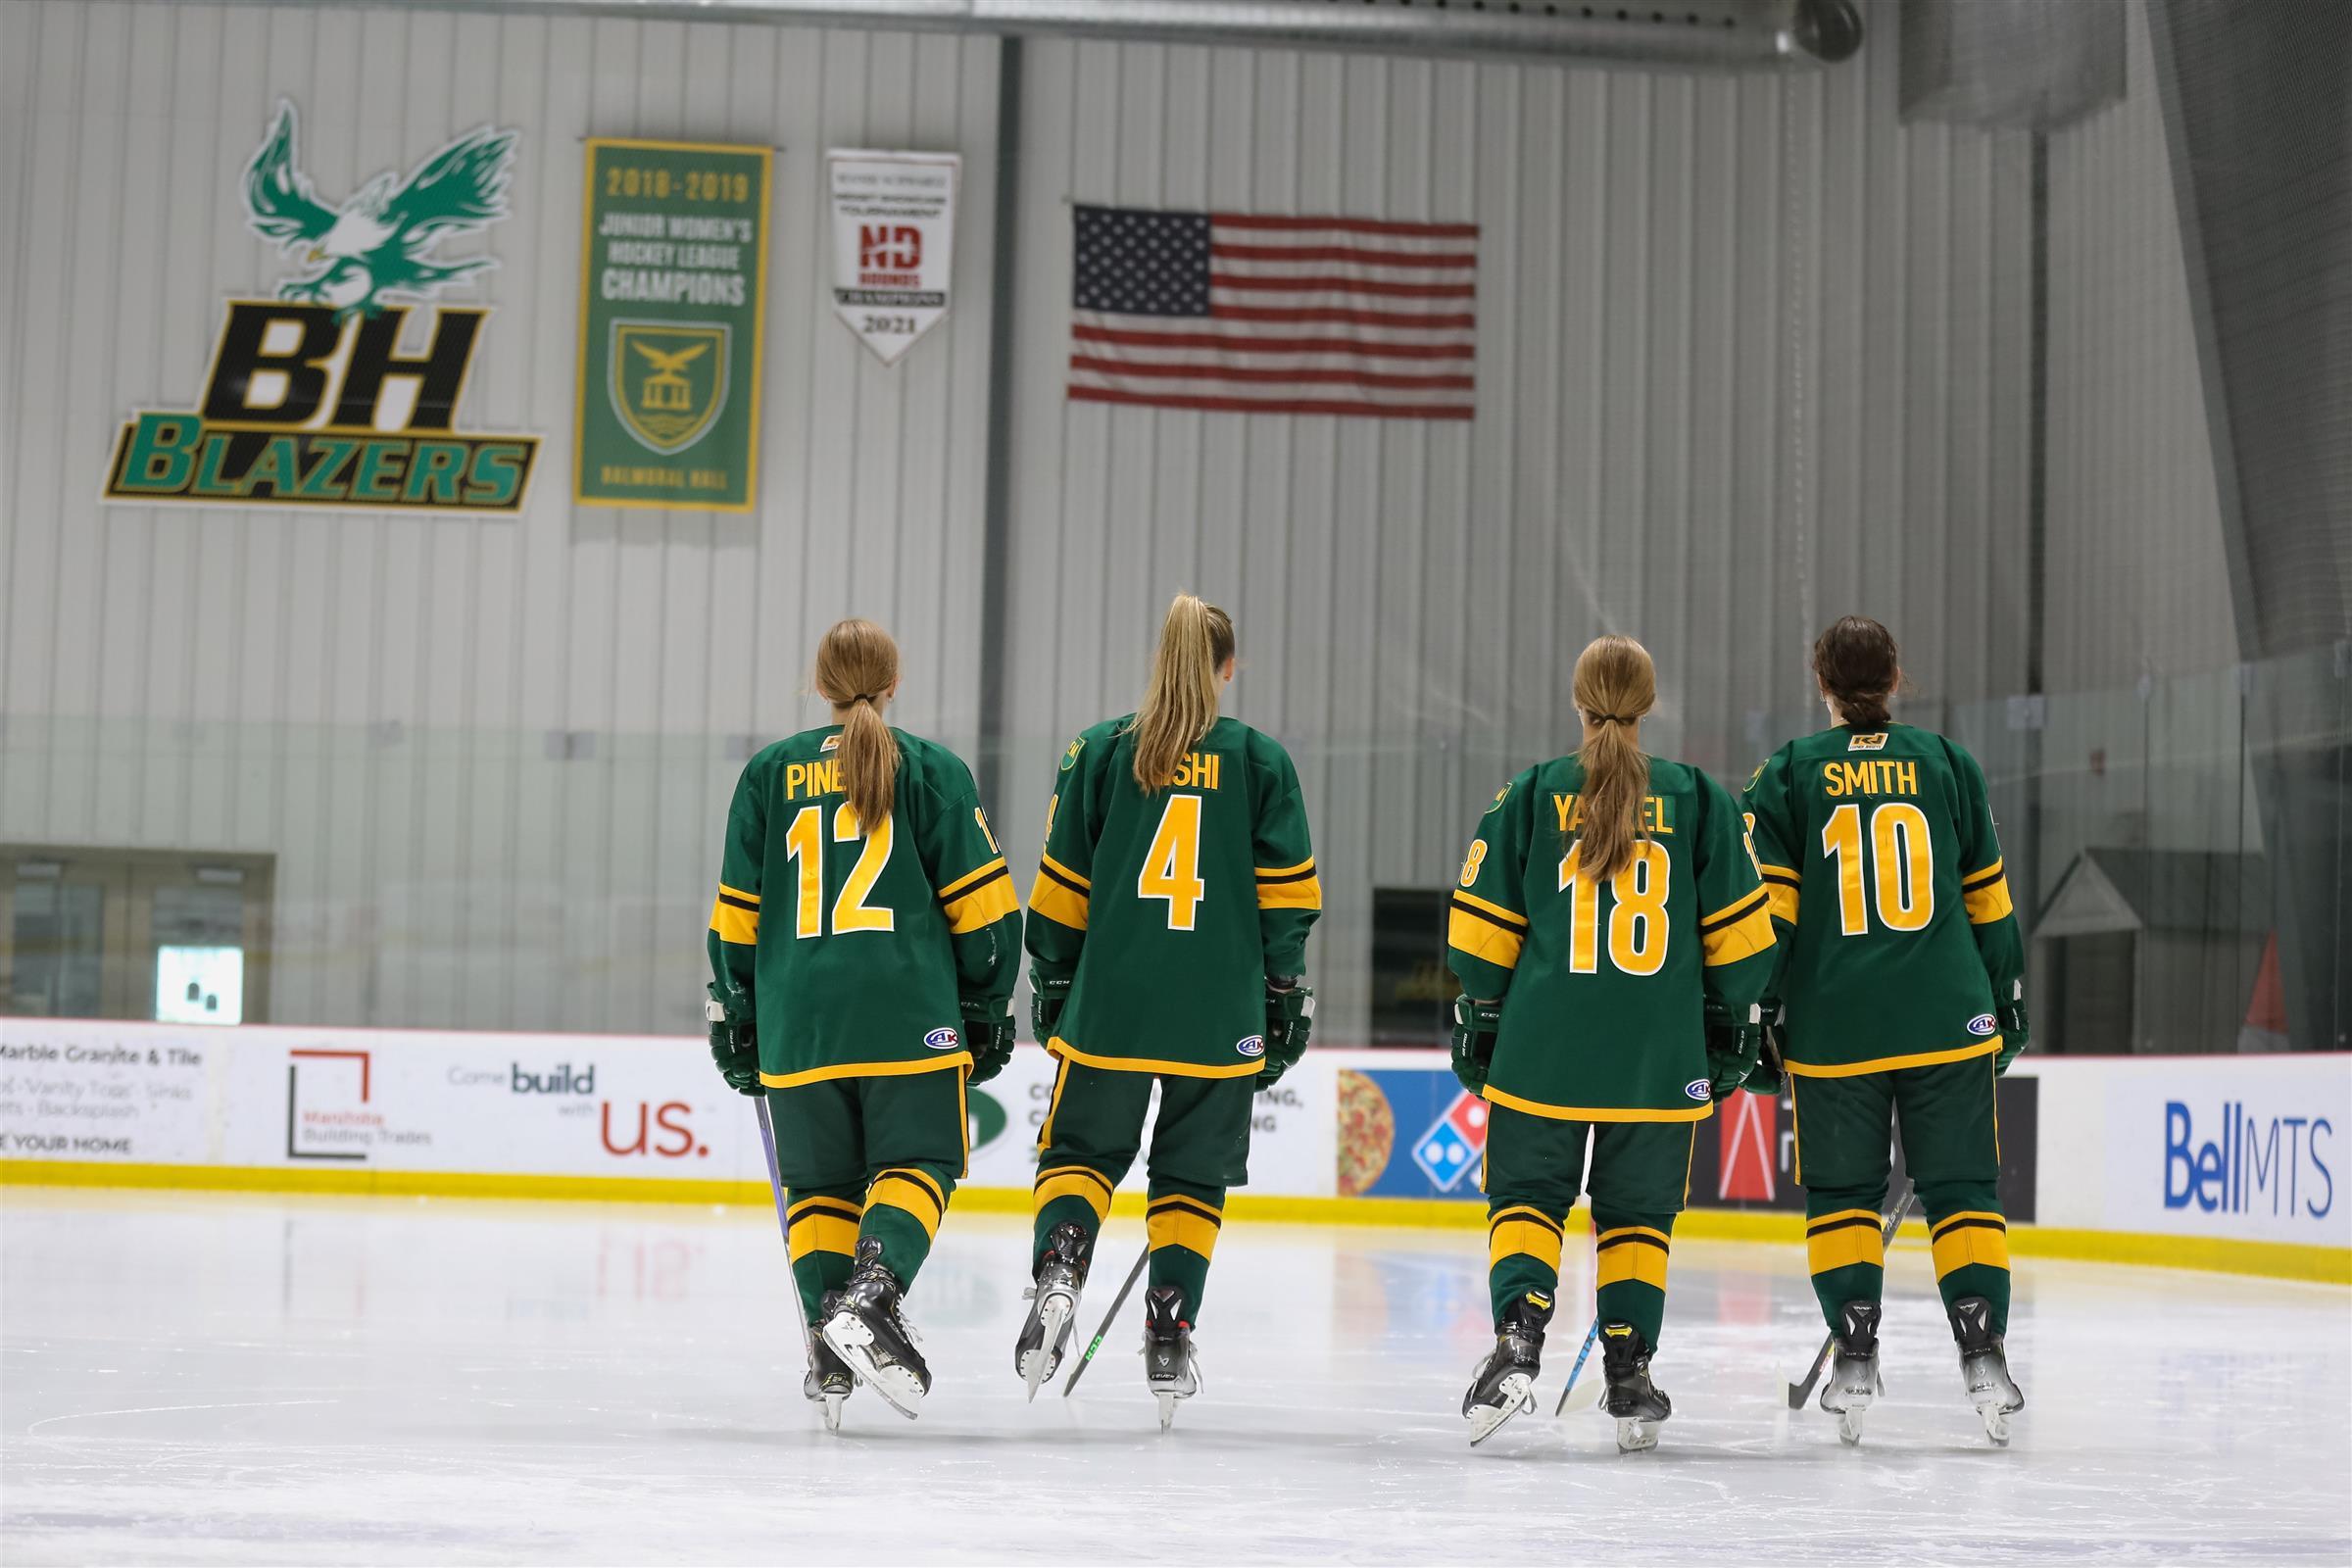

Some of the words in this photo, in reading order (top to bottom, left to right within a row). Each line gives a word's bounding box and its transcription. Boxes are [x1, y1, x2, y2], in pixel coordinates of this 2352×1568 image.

[607, 168, 749, 203] 2018-2019
[599, 213, 665, 237] JUNIOR
[668, 216, 752, 243] WOMEN'S
[859, 225, 922, 270] ND
[608, 240, 675, 266] HOCKEY
[676, 245, 740, 270] LEAGUE
[602, 267, 746, 307] CHAMPIONS
[864, 315, 916, 334] 2021
[201, 299, 490, 431] BH
[117, 412, 525, 505] BLAZERS
[787, 760, 848, 801] PINE
[1171, 752, 1220, 791] SHI
[1824, 760, 1918, 797] SMITH
[1553, 794, 1674, 834] YAEL
[786, 801, 894, 940] 12
[1138, 794, 1205, 931] 4
[1460, 839, 1488, 887] 8
[1821, 802, 1935, 936] 10
[1558, 838, 1671, 976] 18
[64, 1044, 141, 1064] Granite
[148, 1048, 160, 1066] &
[168, 1048, 203, 1066] Tile
[447, 1065, 506, 1086] Come
[511, 1061, 596, 1095] build
[14, 1134, 70, 1152] YOUR
[74, 1137, 132, 1154] HOME
[304, 1128, 372, 1146] Building
[377, 1129, 433, 1145] Trades
[559, 1102, 596, 1117] with
[600, 1100, 710, 1158] us.
